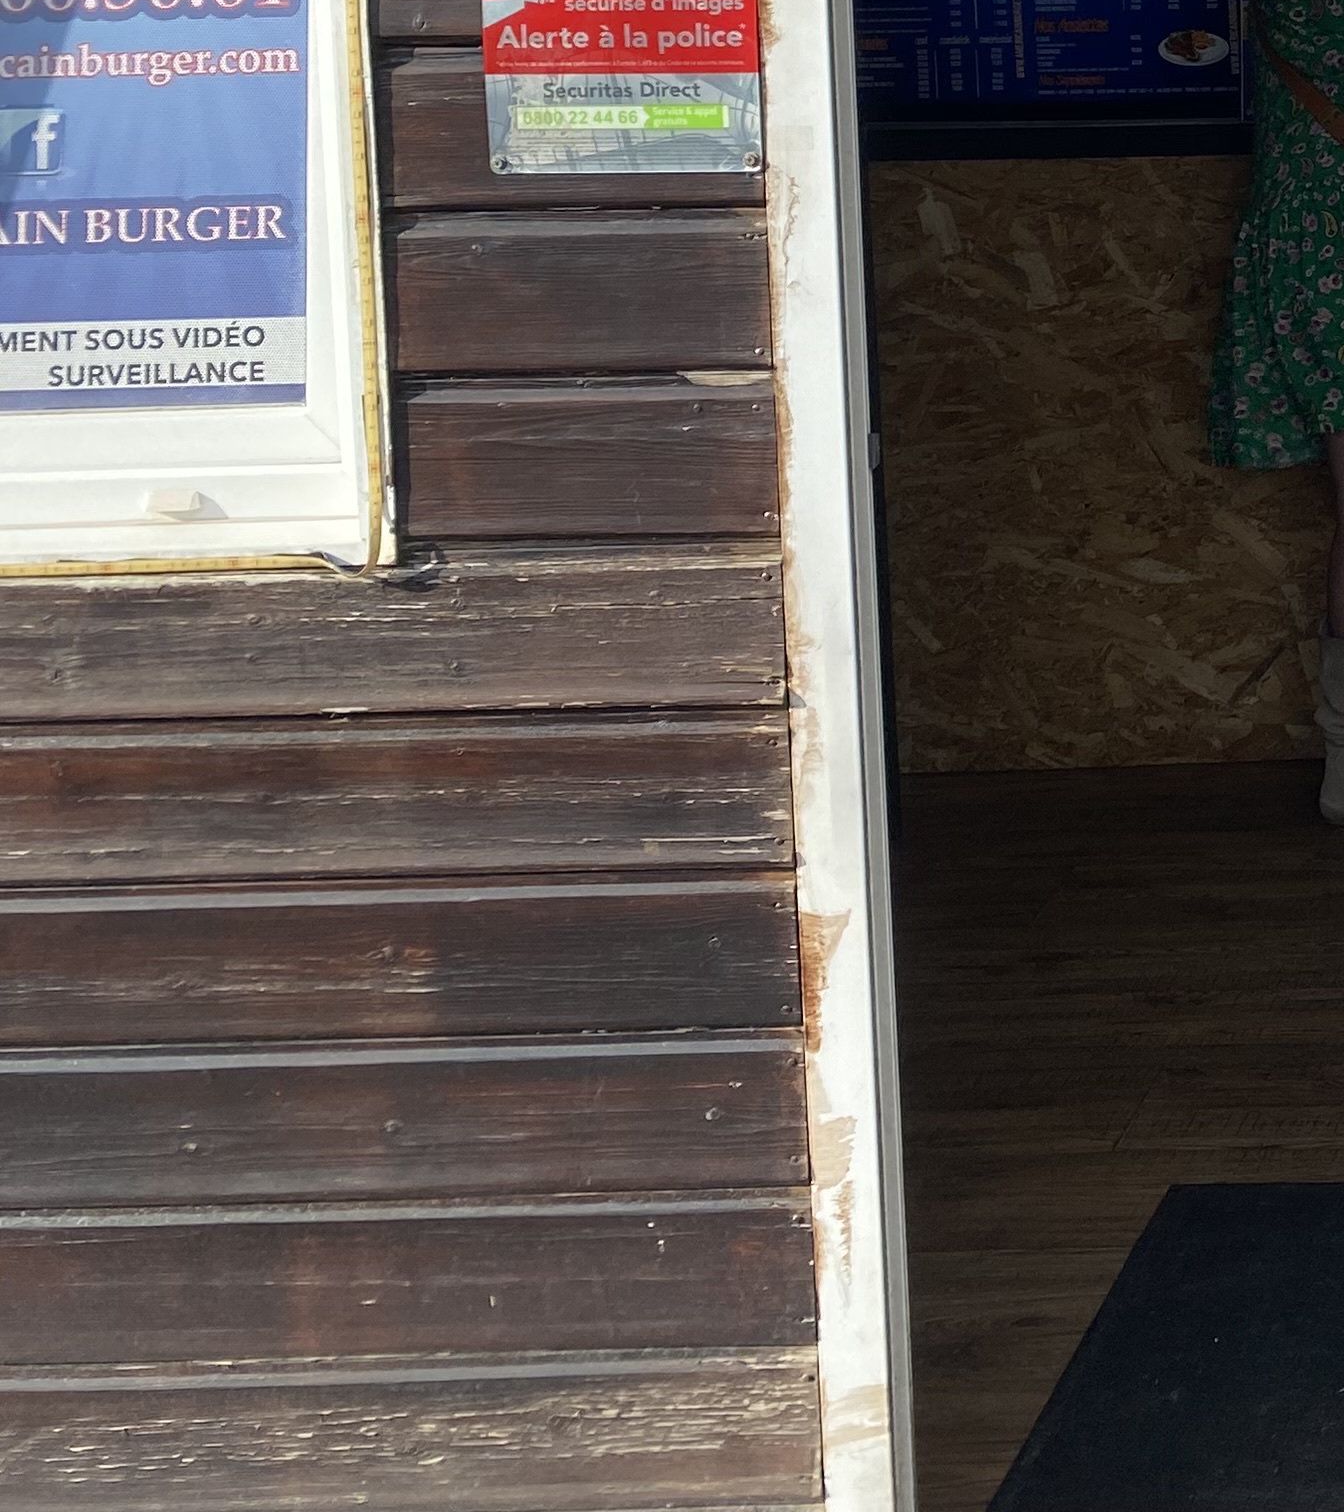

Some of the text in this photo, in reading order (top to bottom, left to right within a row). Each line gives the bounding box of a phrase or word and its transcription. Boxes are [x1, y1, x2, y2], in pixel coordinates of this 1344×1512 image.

[496, 25, 590, 49] Alerte
[600, 24, 615, 48] à
[624, 23, 649, 48] la
[0, 42, 300, 88] cainburger.com
[543, 82, 701, 99] Securitas Direct
[523, 109, 639, 125] 0800 22 44 66
[652, 107, 684, 117] Service
[84, 204, 287, 244] BURGER
[85, 327, 165, 350] SOUS
[172, 320, 266, 349] VIDÉO
[49, 360, 265, 387] SURVEILLANCE
